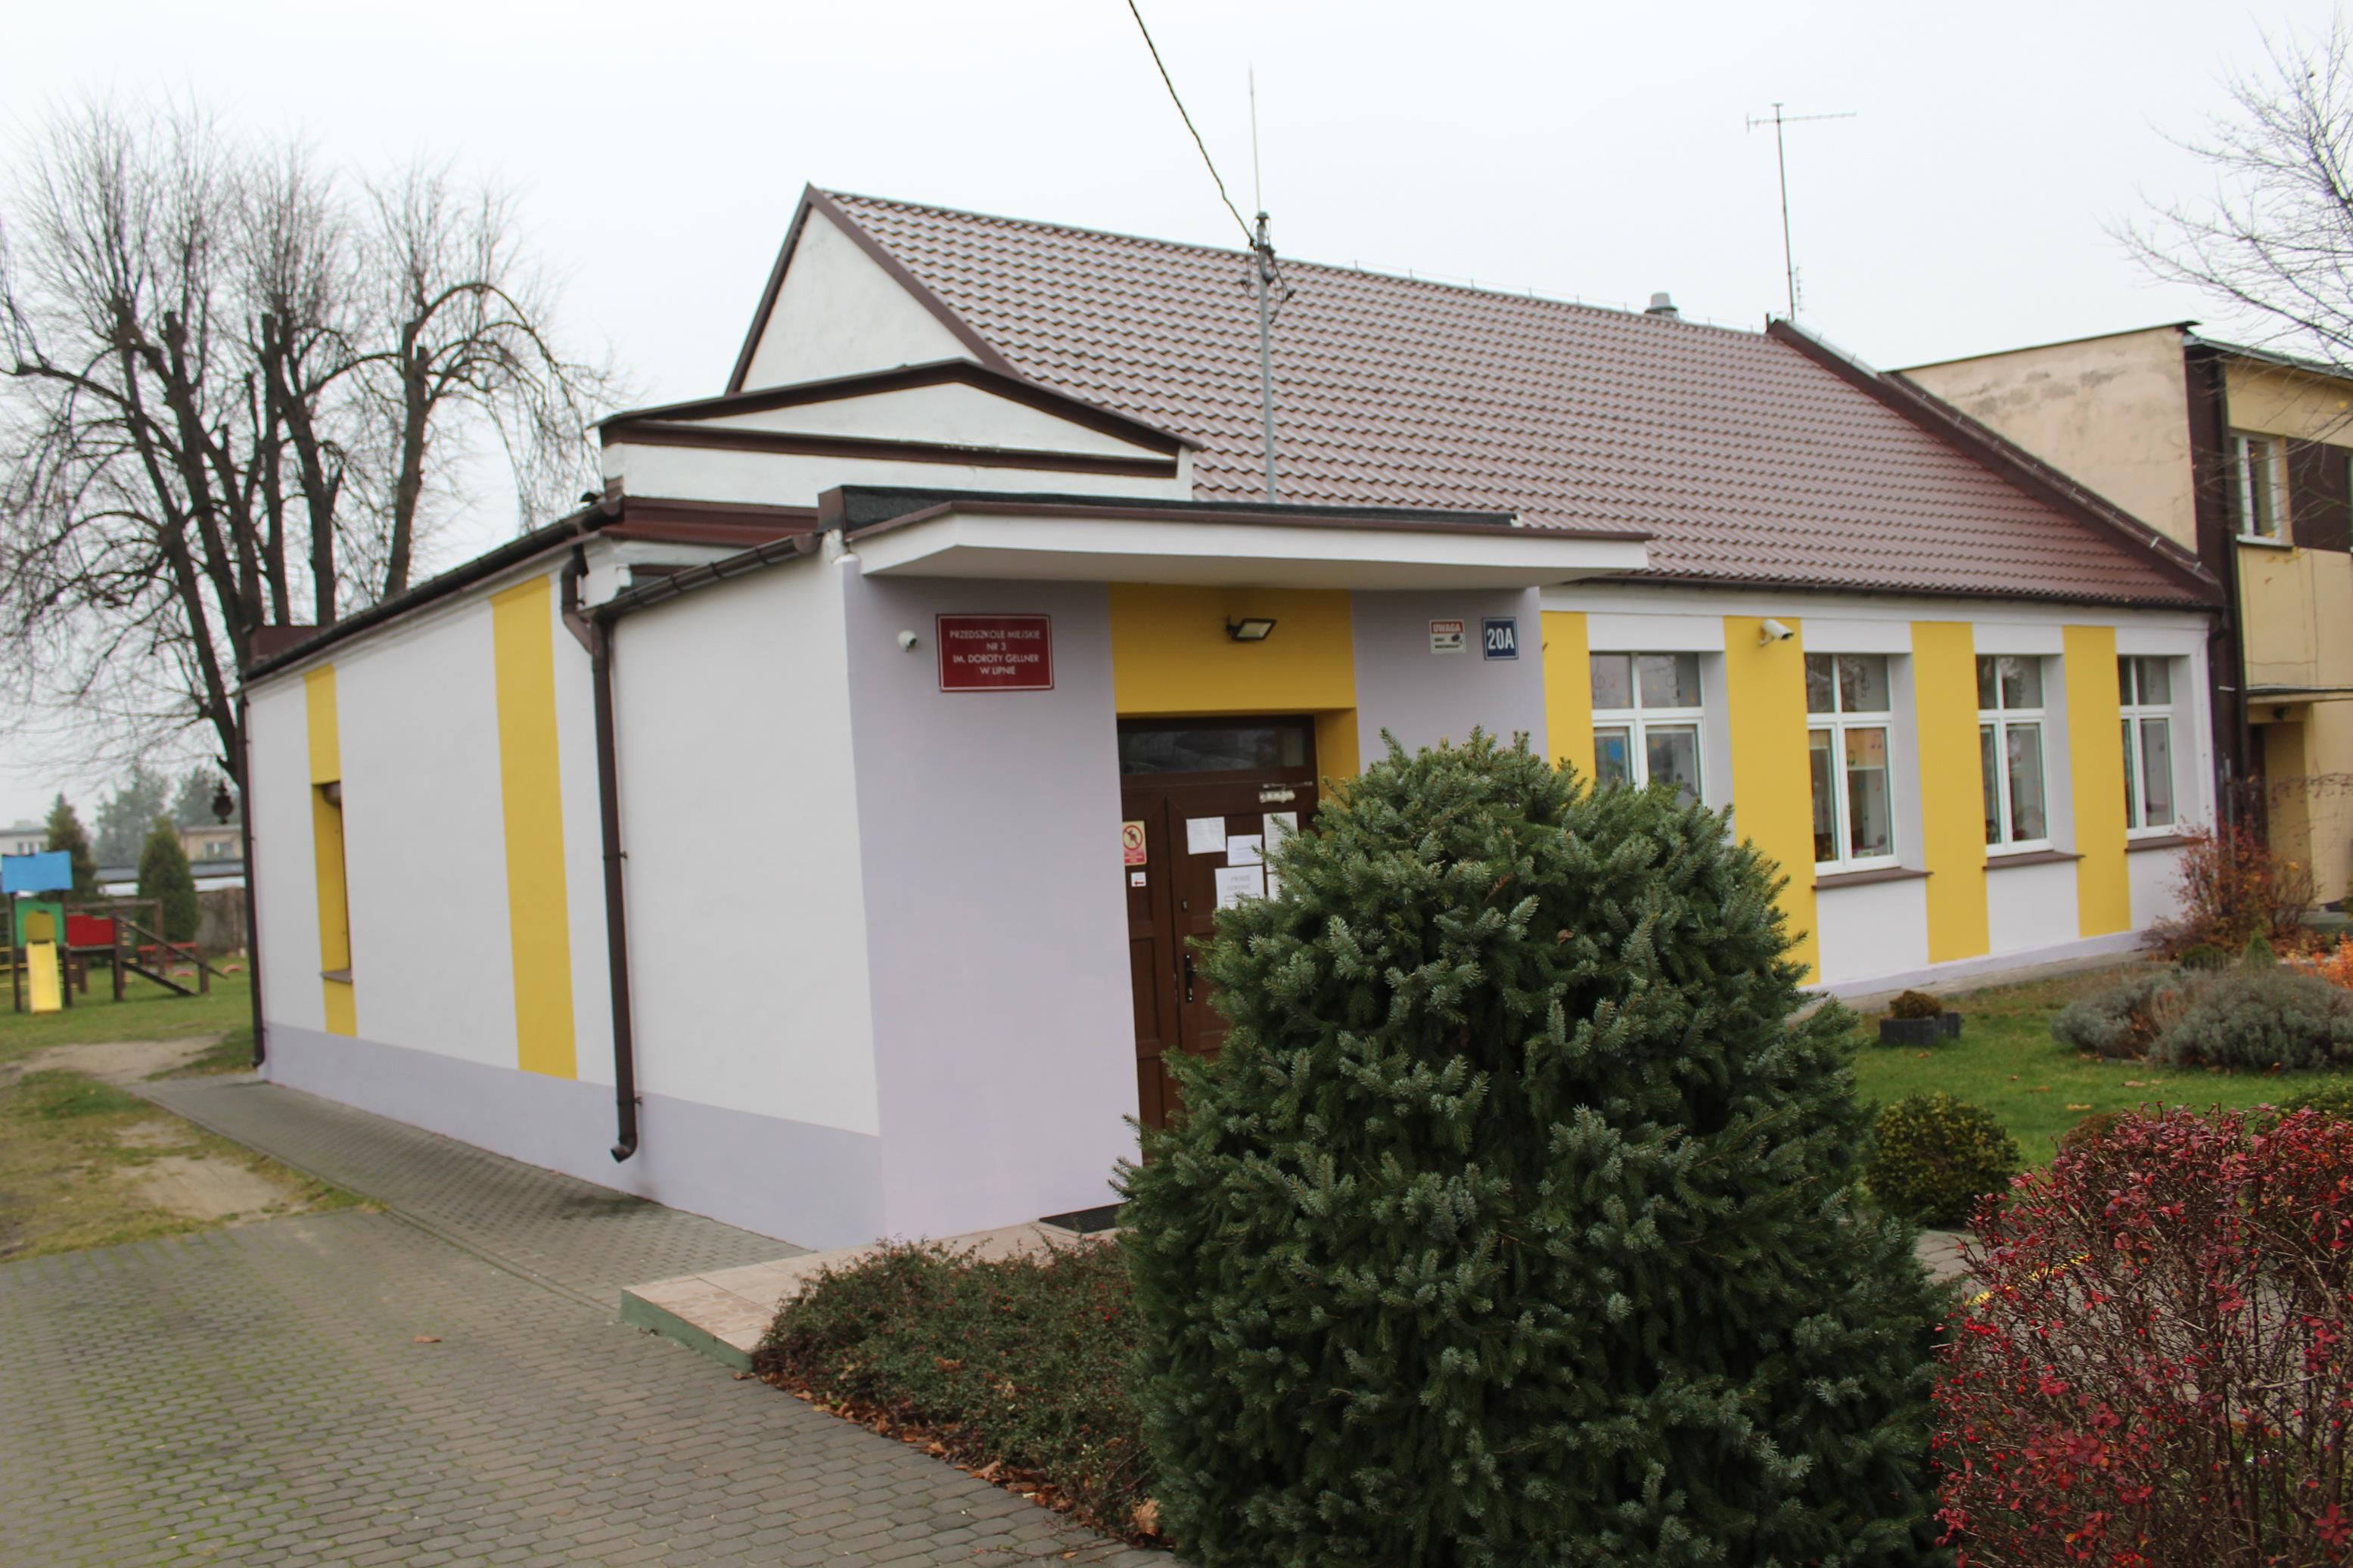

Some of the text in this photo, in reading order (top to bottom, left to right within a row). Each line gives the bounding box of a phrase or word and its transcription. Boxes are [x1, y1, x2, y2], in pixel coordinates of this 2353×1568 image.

[1432, 623, 1462, 632] UWAGA
[950, 630, 1040, 639] PRZEDSZKOLE MIEJSKIE
[1487, 627, 1515, 650] 20A
[953, 654, 1040, 663] IM. DOROTY GELLNER
[980, 666, 1016, 675] W LIPNIE
